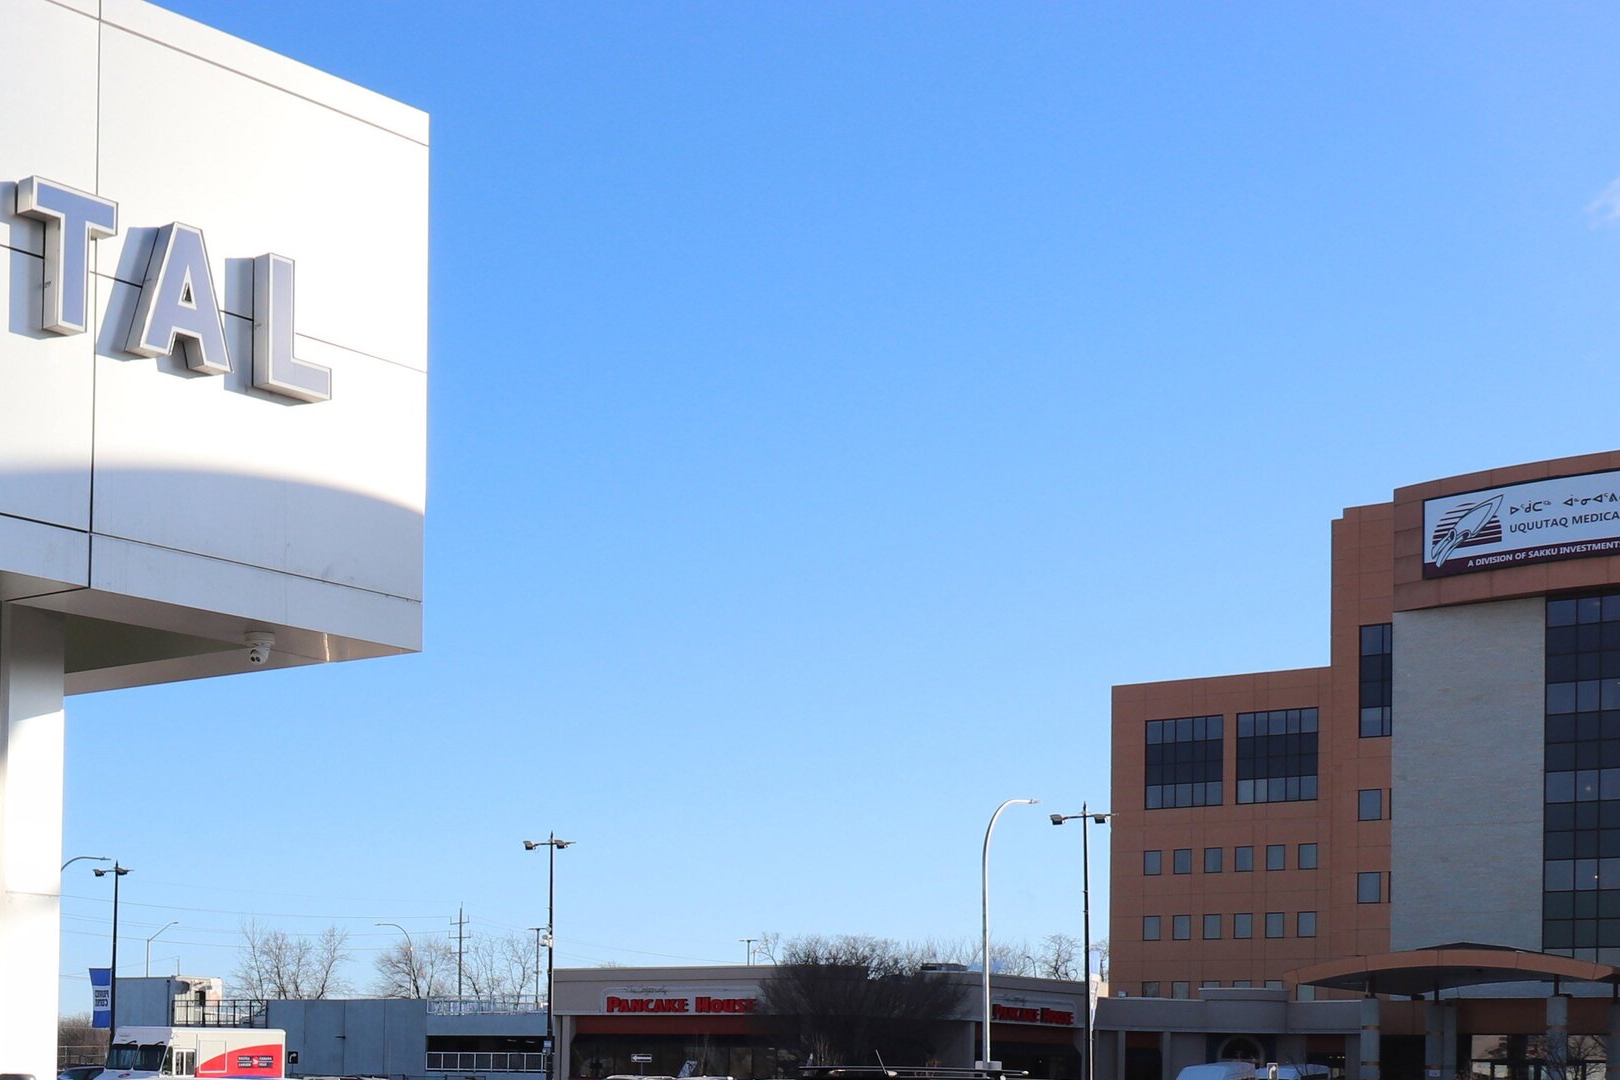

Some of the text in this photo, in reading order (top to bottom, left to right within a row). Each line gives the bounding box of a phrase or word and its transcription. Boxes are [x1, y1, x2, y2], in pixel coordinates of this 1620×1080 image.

[1509, 516, 1569, 534] UQUUTAQ
[1466, 559, 1475, 567] A
[1475, 552, 1513, 566] DIVISION
[1514, 550, 1528, 560] OF
[1528, 548, 1558, 558] SAKKU
[606, 995, 757, 1013] PANCAKE HOUSE
